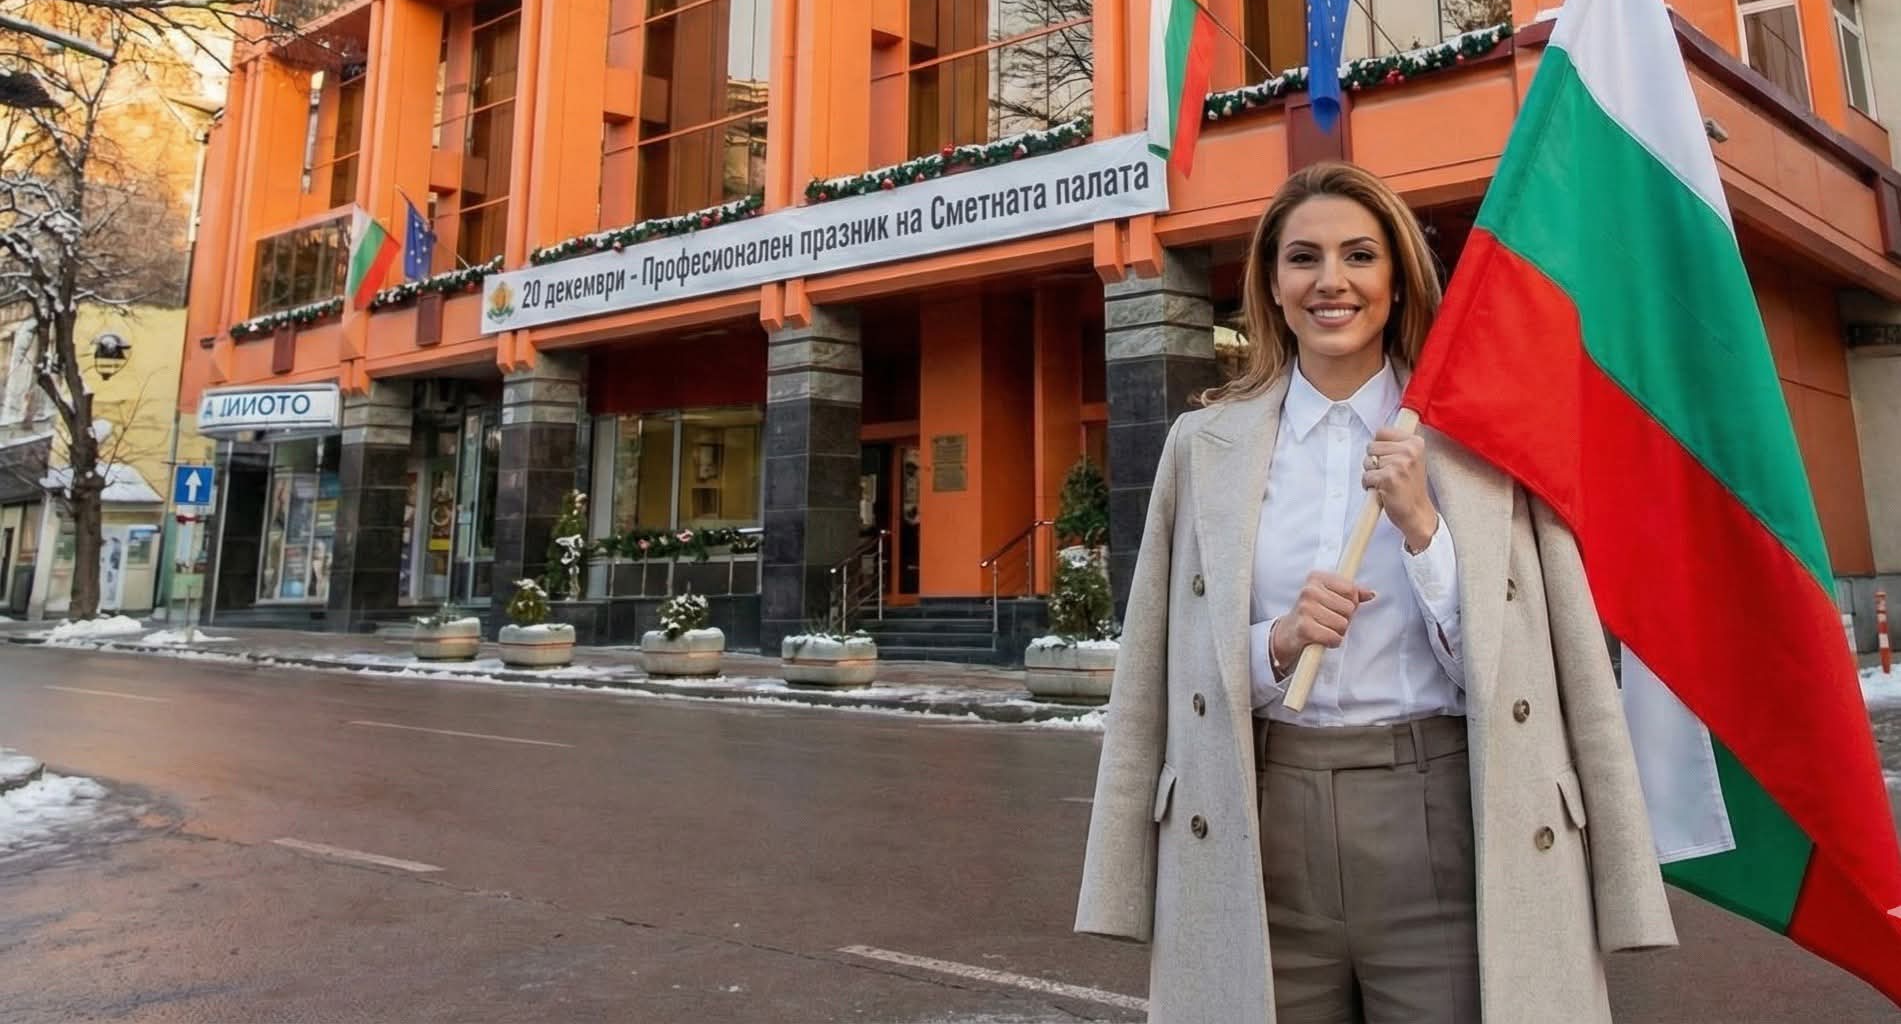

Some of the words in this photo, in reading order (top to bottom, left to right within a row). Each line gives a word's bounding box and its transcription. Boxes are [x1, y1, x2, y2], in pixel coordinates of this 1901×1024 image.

[522, 279, 541, 309] 20
[545, 269, 625, 309] декември
[642, 233, 793, 291] Професионален
[800, 214, 889, 260] празник
[896, 207, 923, 237] на
[931, 182, 1047, 230] Сметната
[1056, 160, 1149, 206] палата
